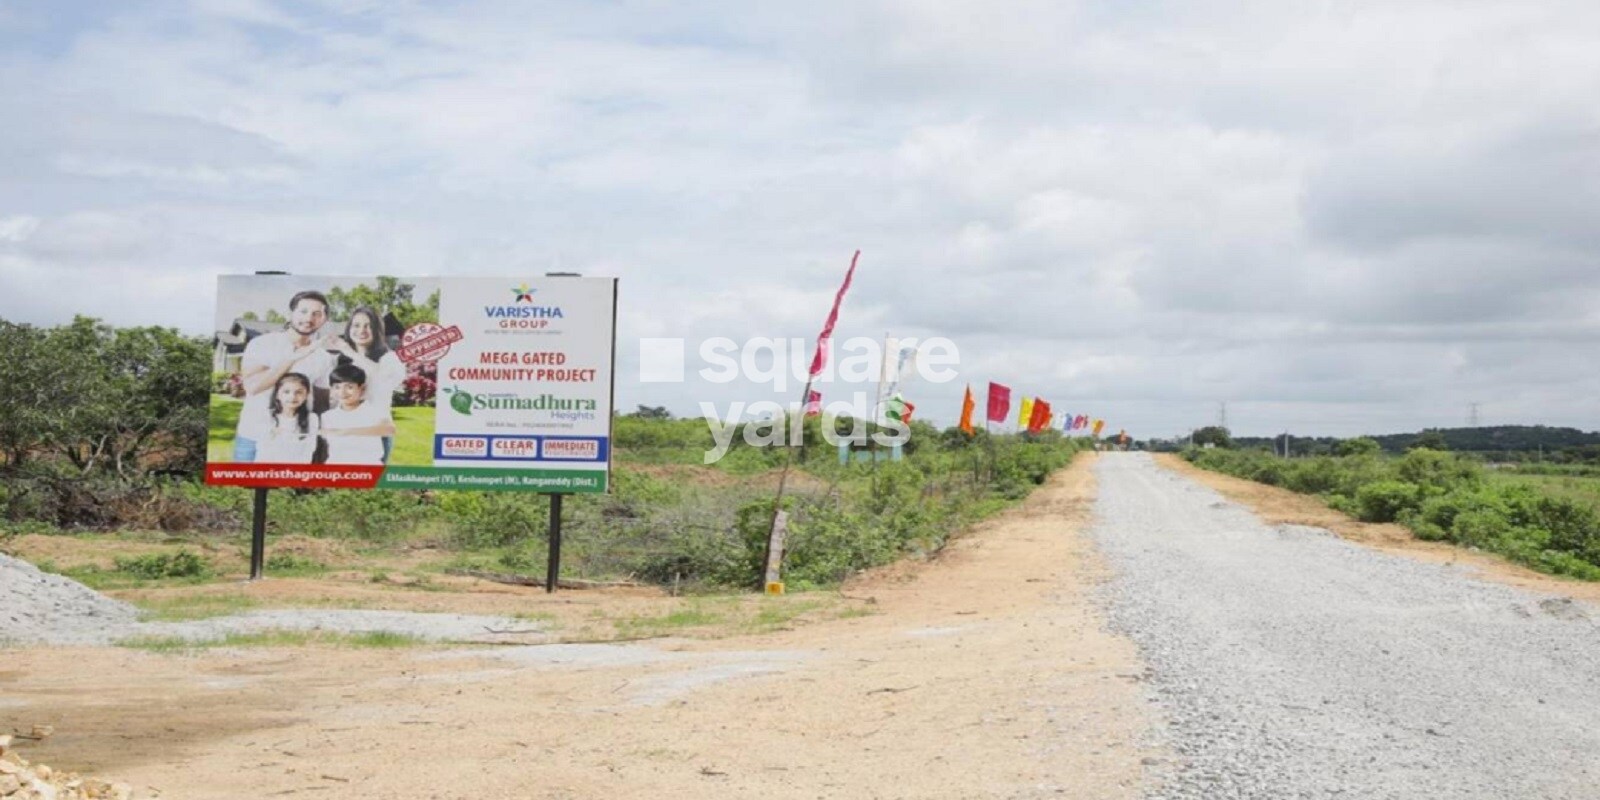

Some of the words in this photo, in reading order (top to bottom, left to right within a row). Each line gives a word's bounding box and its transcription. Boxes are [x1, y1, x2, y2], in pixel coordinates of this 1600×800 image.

[485, 306, 563, 318] VARISTHA
[499, 319, 548, 329] GROUP
[480, 352, 518, 364] MEGA
[522, 353, 566, 365] GATED
[449, 368, 533, 381] COMMUNITY
[537, 369, 596, 382] PROJECT
[473, 393, 596, 411] Sumadhura
[551, 410, 595, 421] Heights
[445, 440, 485, 448] GATED
[495, 440, 534, 449] CLEAR
[545, 442, 596, 451] IMMEDIATE
[212, 468, 372, 482] www.varisthagroup.com
